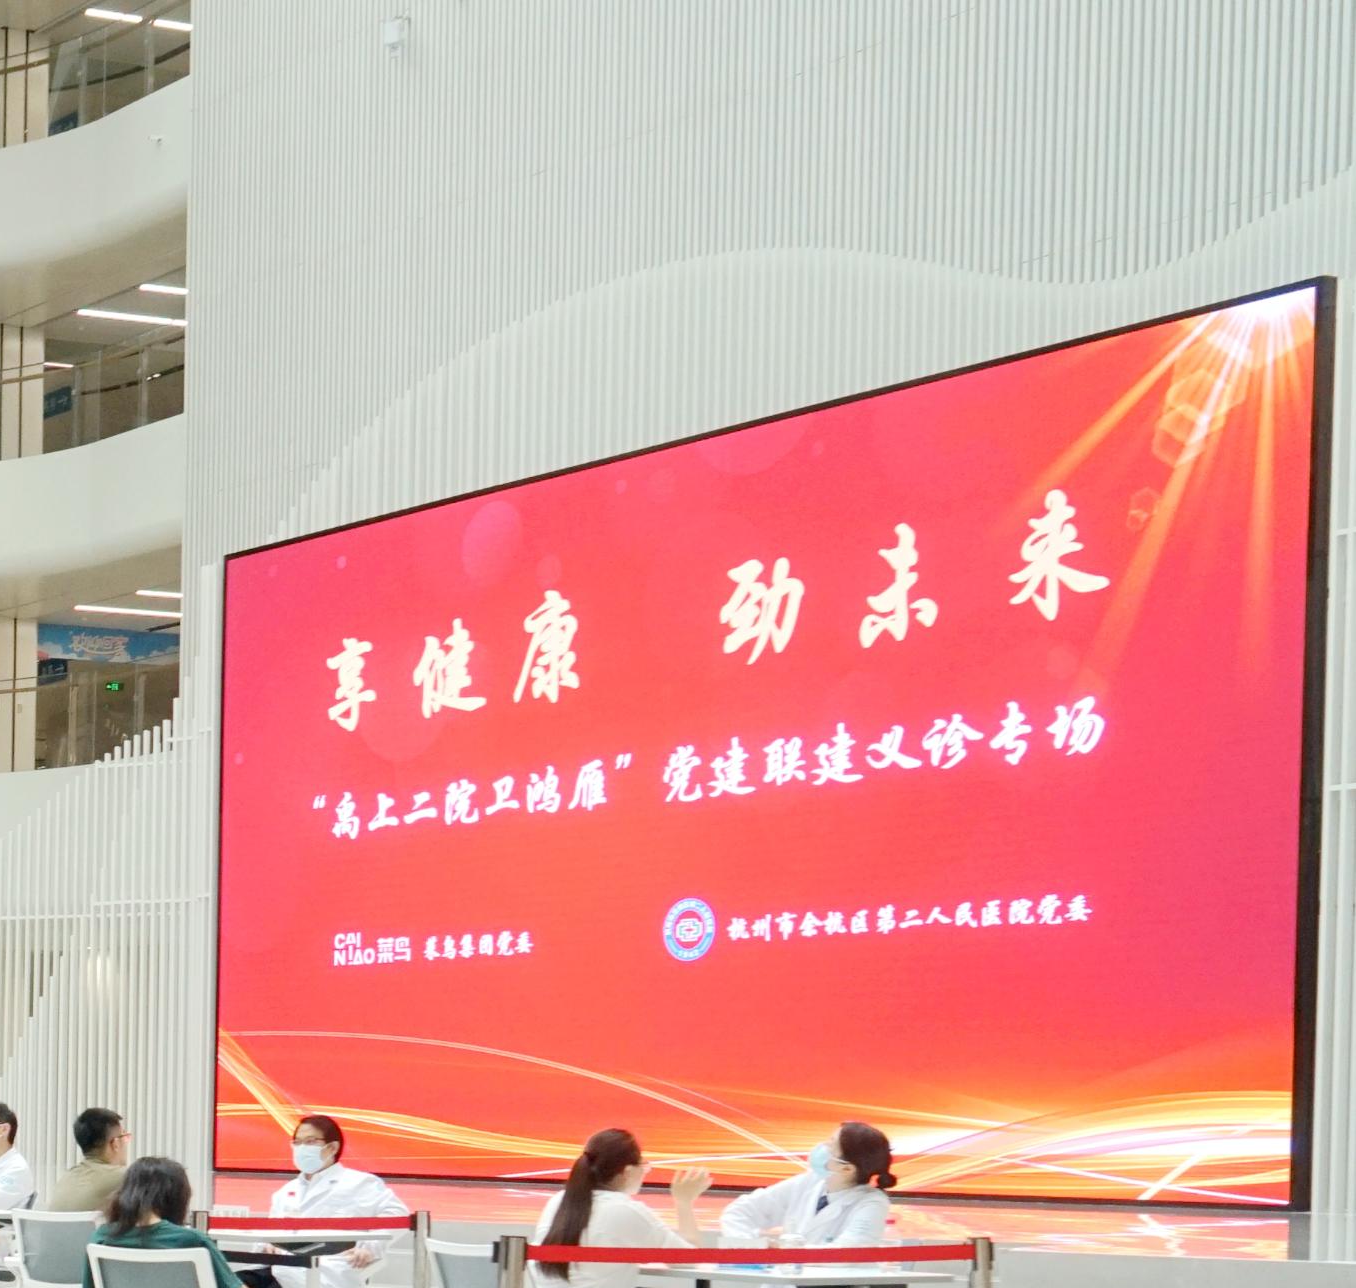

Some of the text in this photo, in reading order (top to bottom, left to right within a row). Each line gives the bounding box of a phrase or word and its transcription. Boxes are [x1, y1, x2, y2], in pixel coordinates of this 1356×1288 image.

[327, 490, 1109, 731] 享健康 劲未来
[727, 894, 1092, 941] 杭州市余杭区第二人民医院党委
[377, 937, 411, 963] 菜鸟
[424, 931, 534, 960] 菜鸟集团党委
